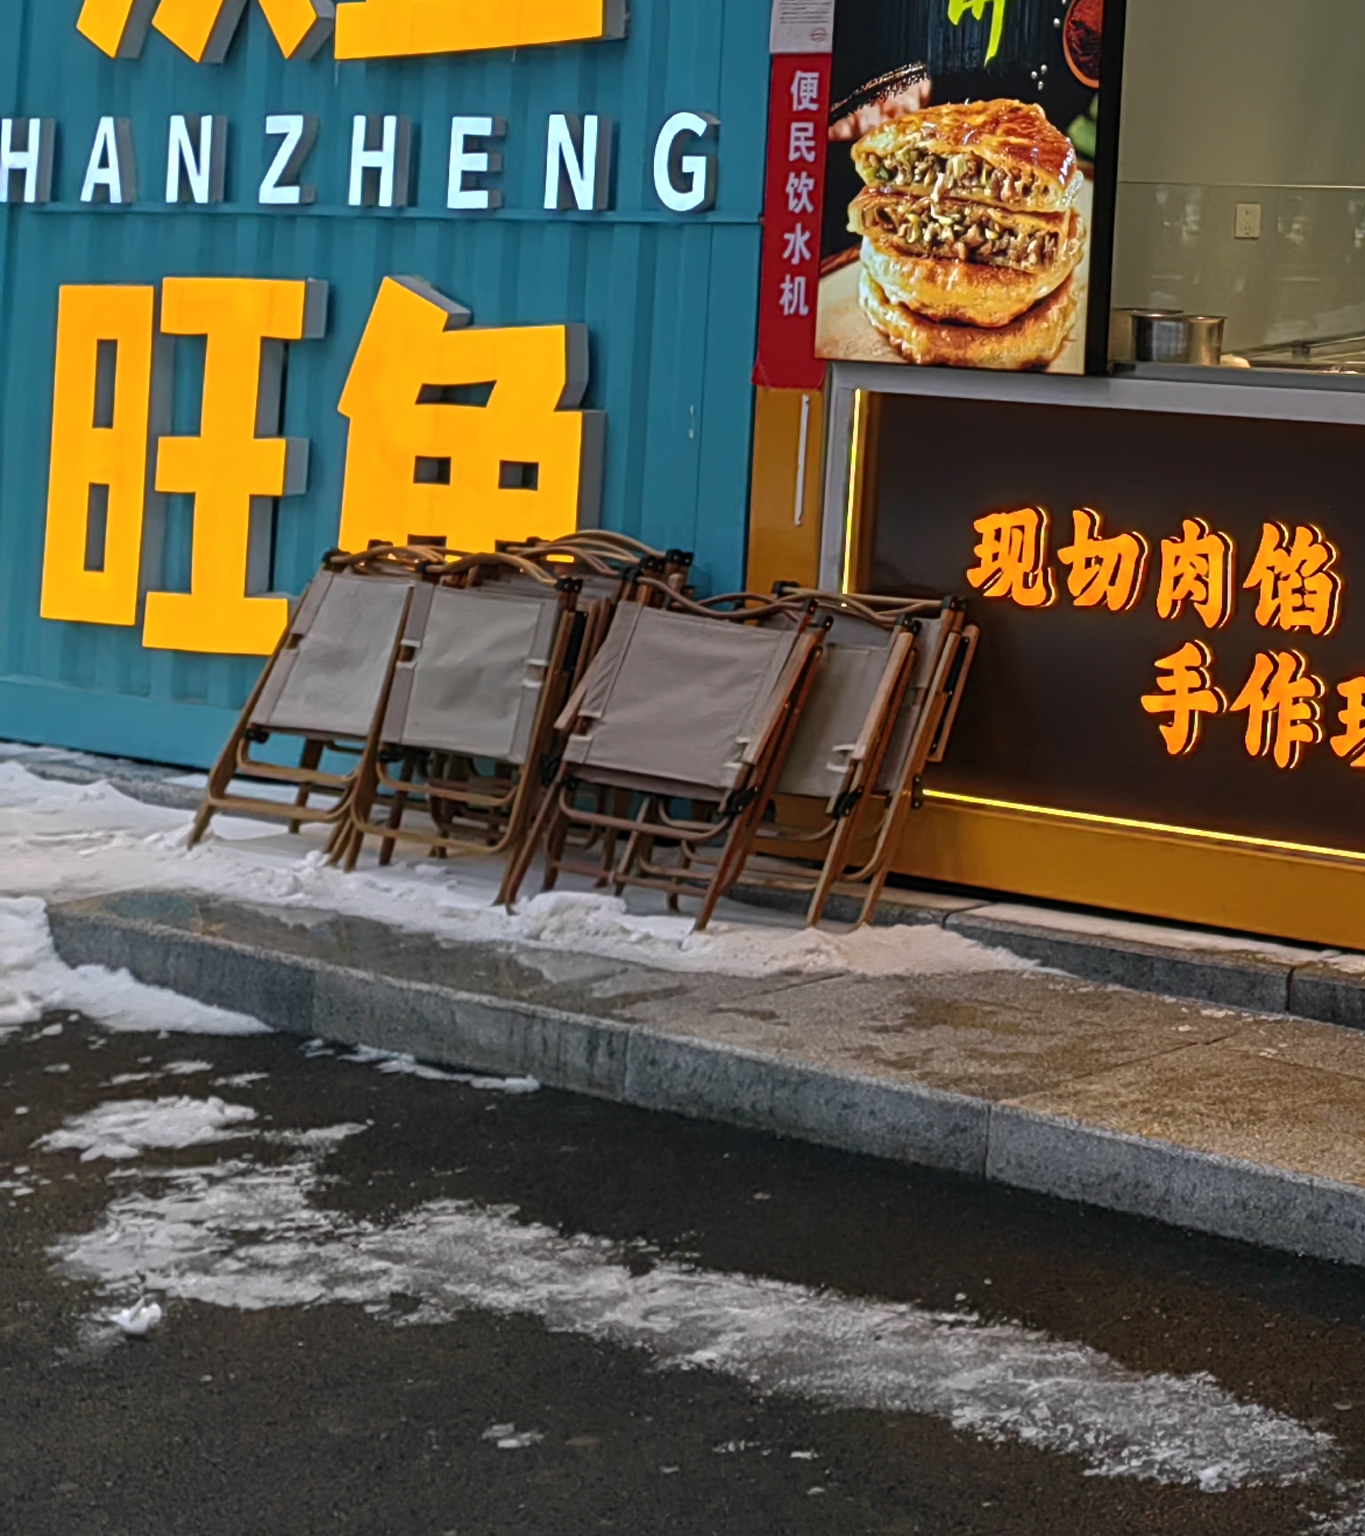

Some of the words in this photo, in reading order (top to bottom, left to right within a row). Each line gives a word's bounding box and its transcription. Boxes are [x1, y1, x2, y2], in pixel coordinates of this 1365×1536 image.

[0, 111, 710, 212] HANZHENG
[778, 69, 821, 317] 便民饮水机
[40, 276, 583, 656] 旺角
[966, 506, 1342, 636] 现切肉馅
